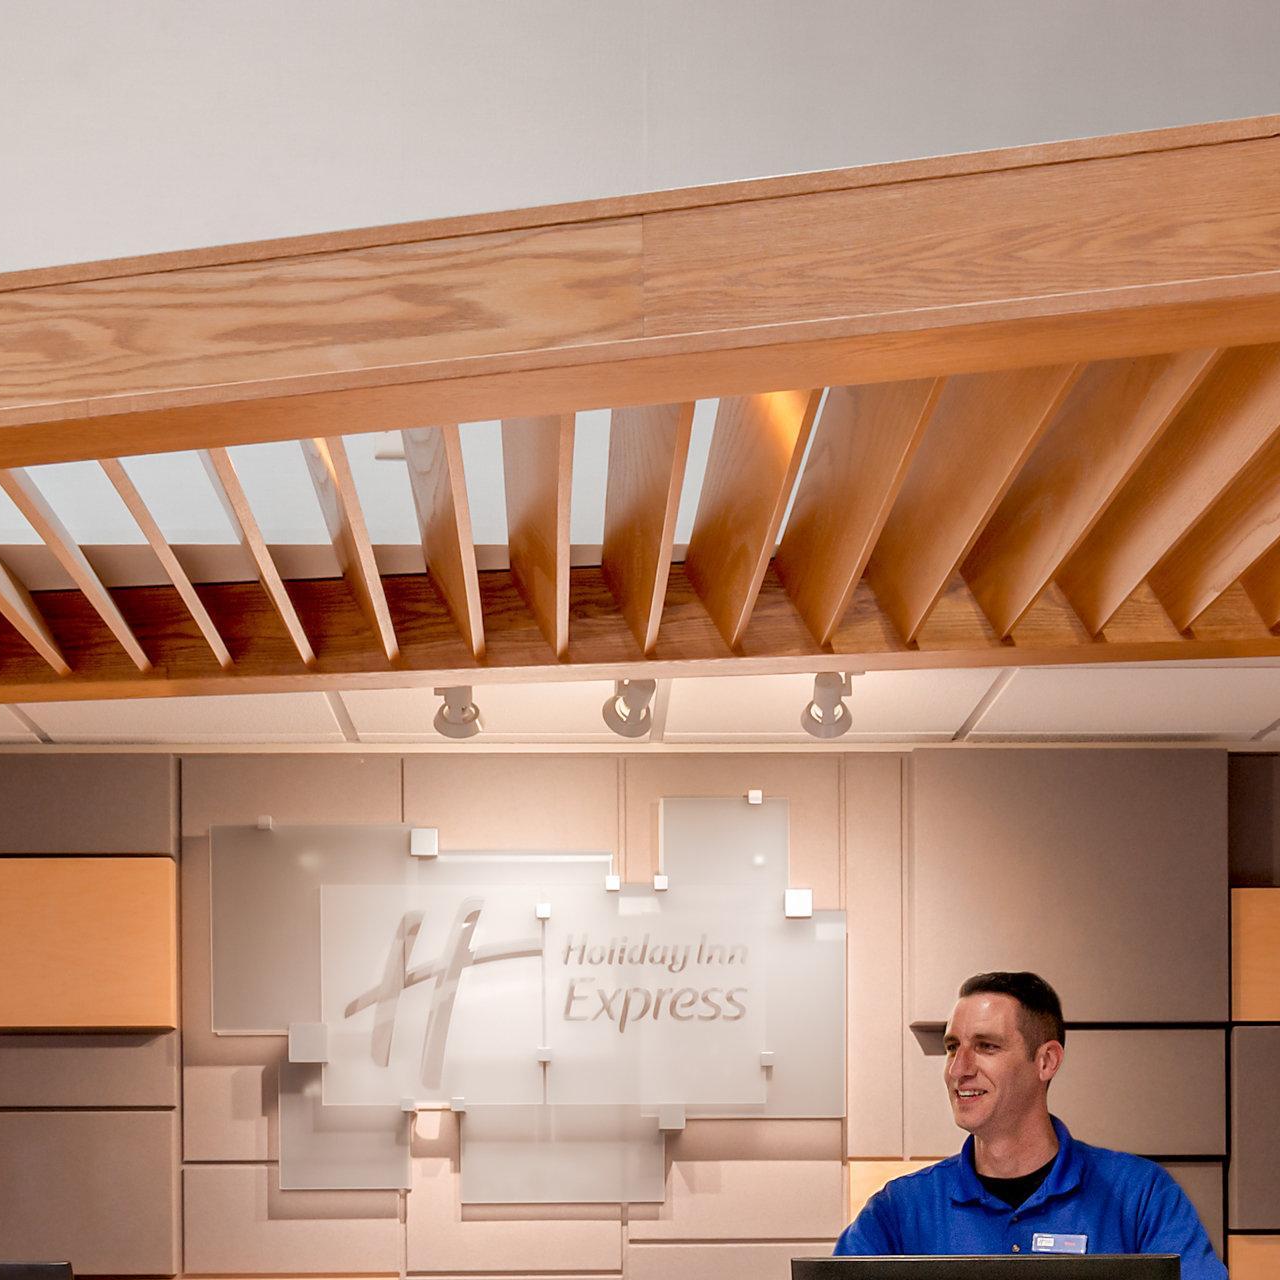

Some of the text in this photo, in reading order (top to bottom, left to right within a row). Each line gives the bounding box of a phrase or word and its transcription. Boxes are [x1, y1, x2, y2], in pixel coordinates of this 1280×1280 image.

[562, 934, 749, 973] Holiday Inn
[563, 976, 749, 1034] Express
